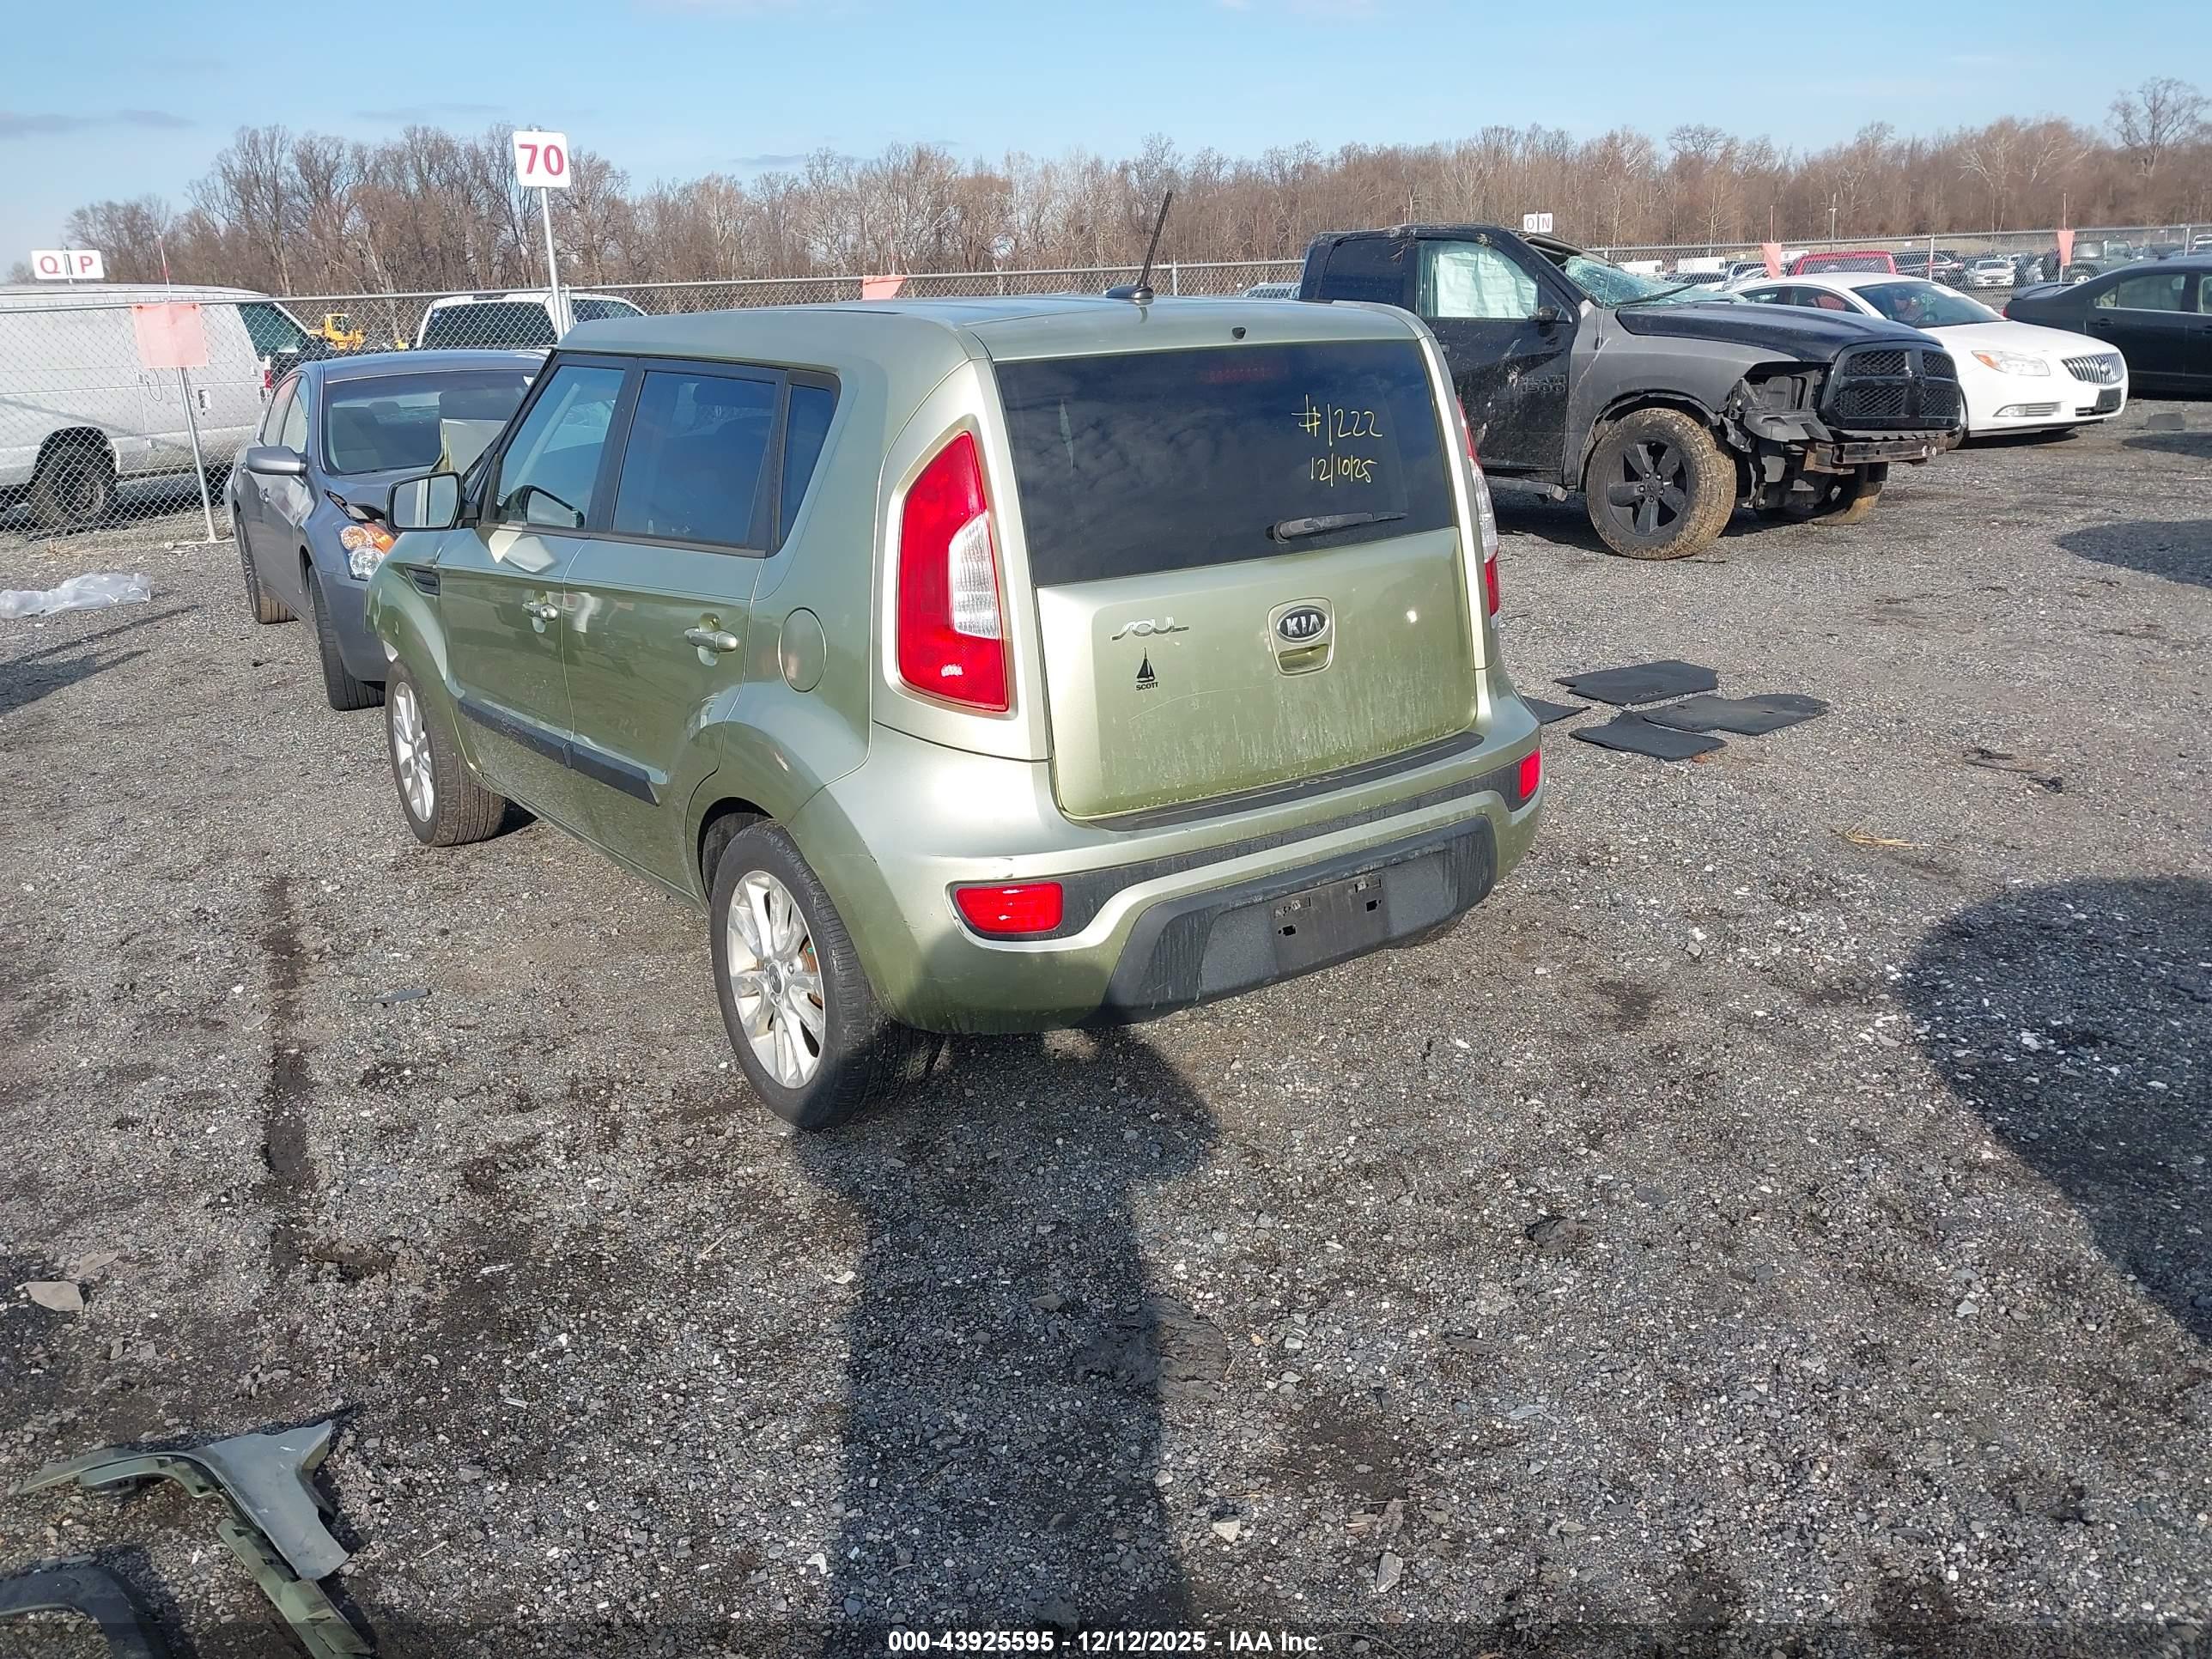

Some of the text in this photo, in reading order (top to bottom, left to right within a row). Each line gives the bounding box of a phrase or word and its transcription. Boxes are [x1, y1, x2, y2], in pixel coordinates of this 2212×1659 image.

[519, 144, 564, 175] 70
[1542, 216, 1551, 229] N
[40, 256, 94, 274] Q P
[1291, 393, 1383, 447] #1222
[1310, 453, 1378, 488] 12/10/25
[1110, 617, 1189, 641] SOUL
[1285, 614, 1322, 636] KIA
[1135, 681, 1159, 691] SCOTT
